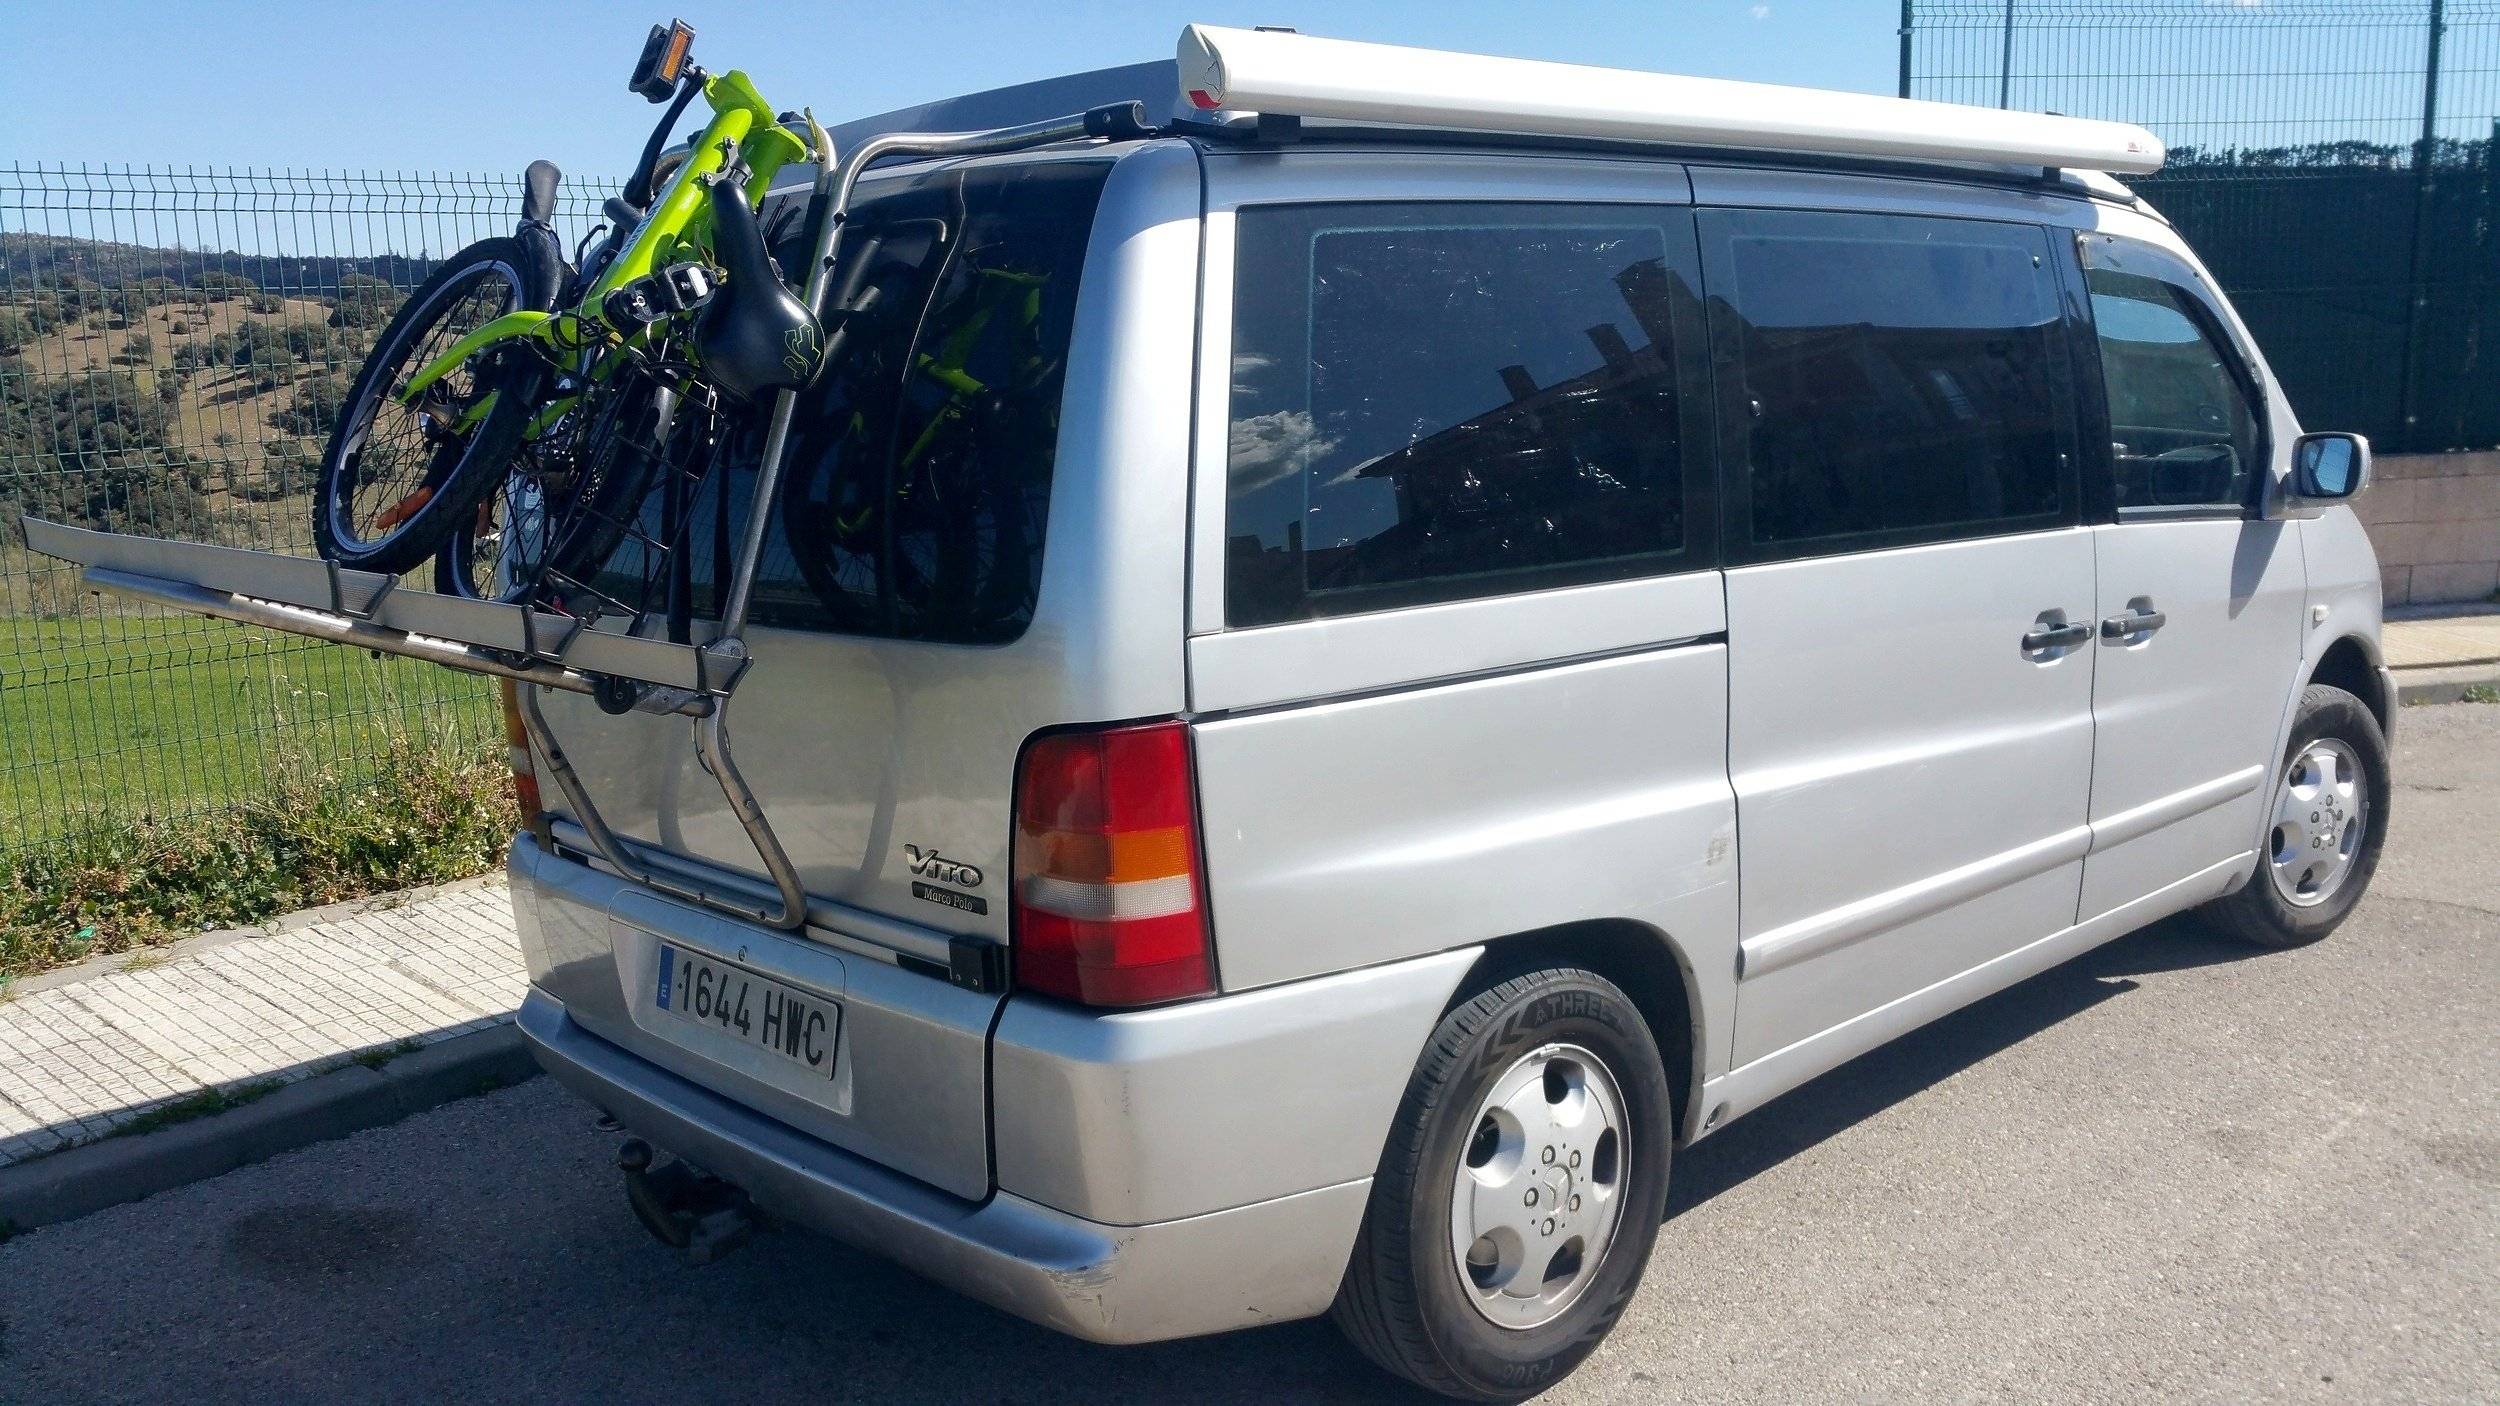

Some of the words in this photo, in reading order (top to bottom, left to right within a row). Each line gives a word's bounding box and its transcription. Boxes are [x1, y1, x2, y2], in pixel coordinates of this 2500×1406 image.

[924, 887, 951, 904] Marco
[954, 896, 973, 911] Polo
[682, 961, 750, 1036] 1644
[762, 991, 826, 1066] HWC
